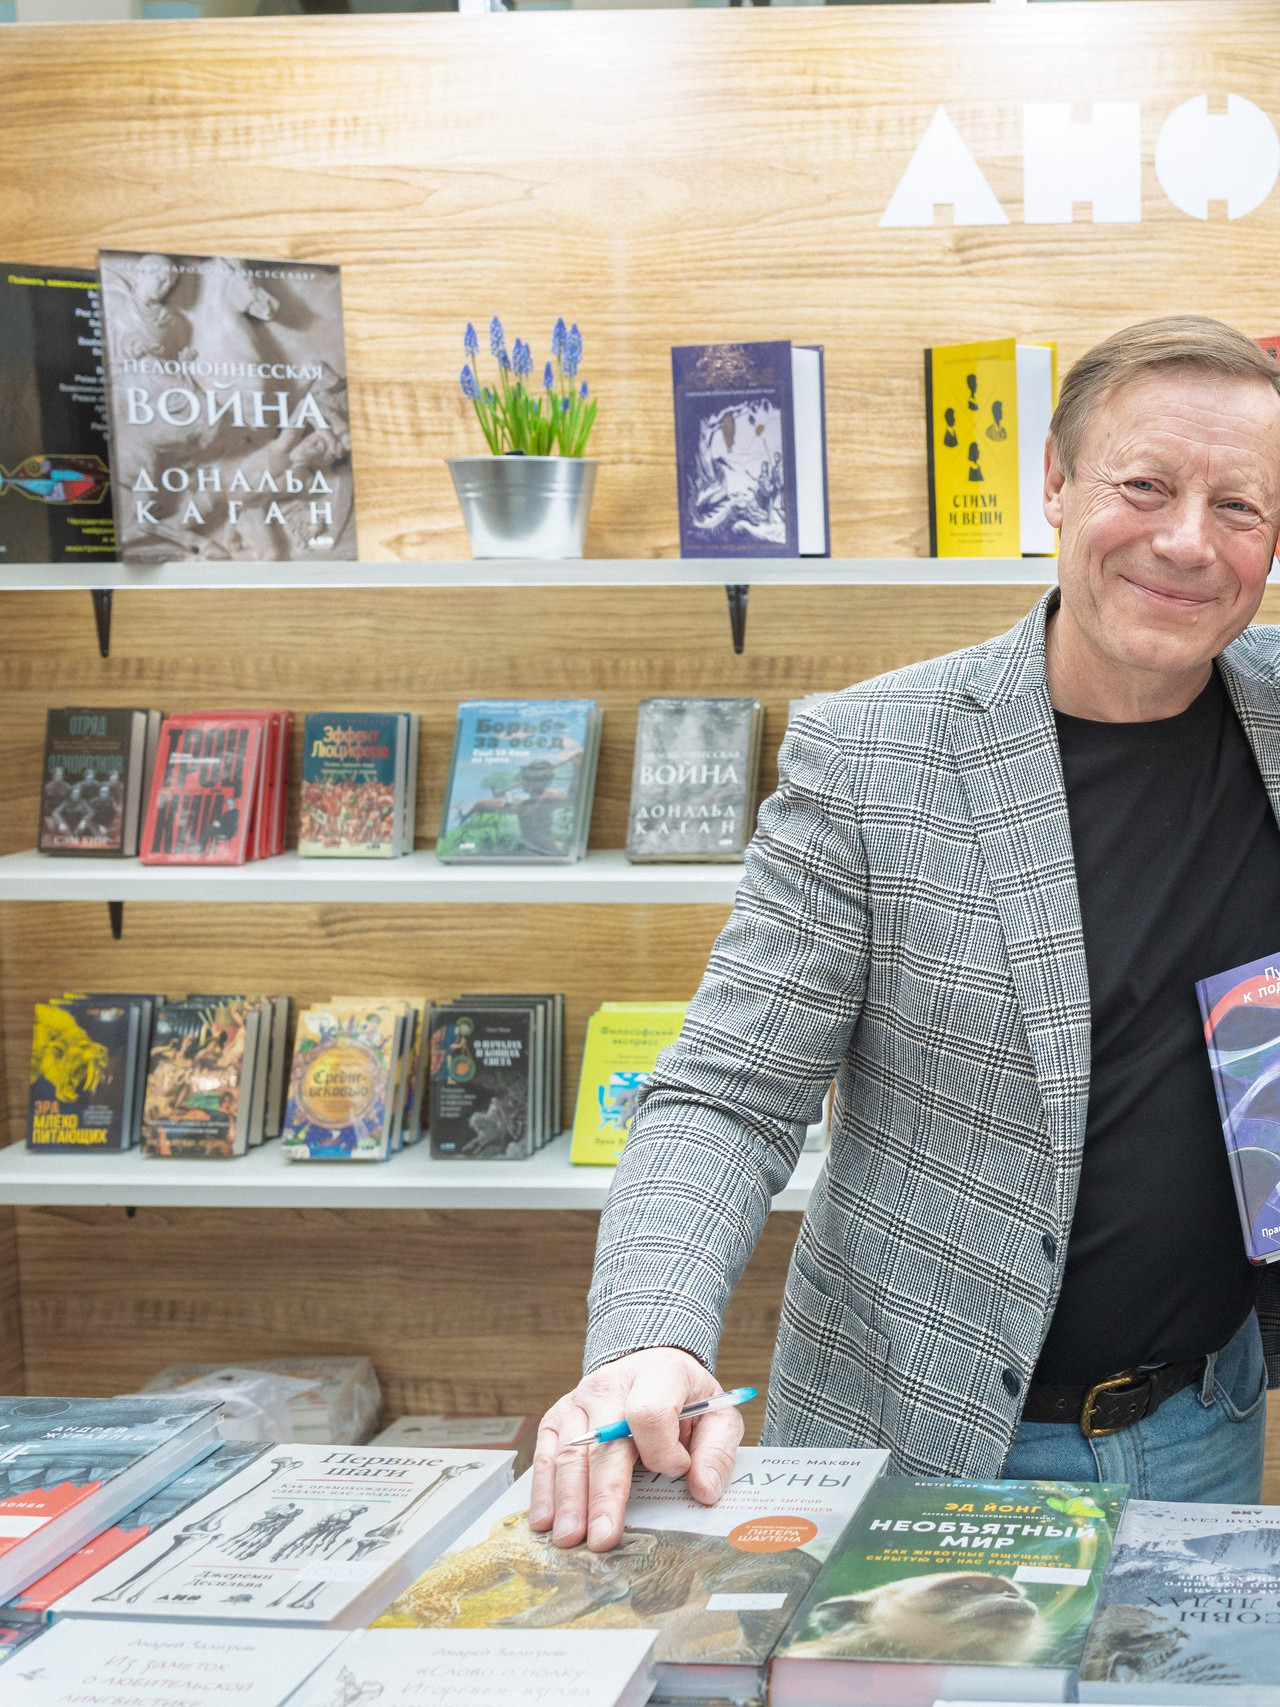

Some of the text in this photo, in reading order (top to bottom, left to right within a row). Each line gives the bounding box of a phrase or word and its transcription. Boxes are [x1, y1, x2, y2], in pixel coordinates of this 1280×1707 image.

[122, 359, 324, 381] ПЕЛОПОННЕССКАЯ
[126, 381, 331, 429] ВОЙНА
[132, 467, 334, 493] ДОНАЛЬД
[953, 494, 997, 508] СТИХИ
[135, 500, 334, 525] КАГАН
[640, 760, 740, 786] ВОЙНА
[635, 804, 736, 819] ДОНАЛЬД
[635, 820, 735, 836] КАГАН
[34, 1100, 60, 1115] ЭРА
[32, 1114, 80, 1130] МЛЕКО
[32, 1128, 109, 1146] ПИТАЮЩИХ
[51, 1425, 130, 1434] АНДРЕЙ
[41, 1432, 148, 1442] ЖУРАВЛЕВ
[319, 1452, 444, 1468] Первые
[761, 1458, 862, 1467] РОСС МАКФИ
[323, 1466, 413, 1478] шаги
[772, 1505, 834, 1514] ЛЕНИВЦЕВ
[943, 1502, 1043, 1514] ЭД ЙОНГ
[747, 1528, 801, 1537] ПИТЕРА
[868, 1519, 1098, 1539] НЕОБЪЯТНЫЙ
[737, 1535, 802, 1544] ШАУТЕНА
[938, 1535, 1016, 1550] МИР
[865, 1555, 1073, 1569] СКРЫТУЮ ОТ НАС РЕАЛЬНОСТЬ
[883, 1548, 1061, 1562] КАК ЖИВОТНЫЕ ОЩУЩАЮТ
[193, 1570, 275, 1581] Джереми
[183, 1579, 264, 1589] Десильва
[1144, 1596, 1263, 1609] ЛЬДАХ
